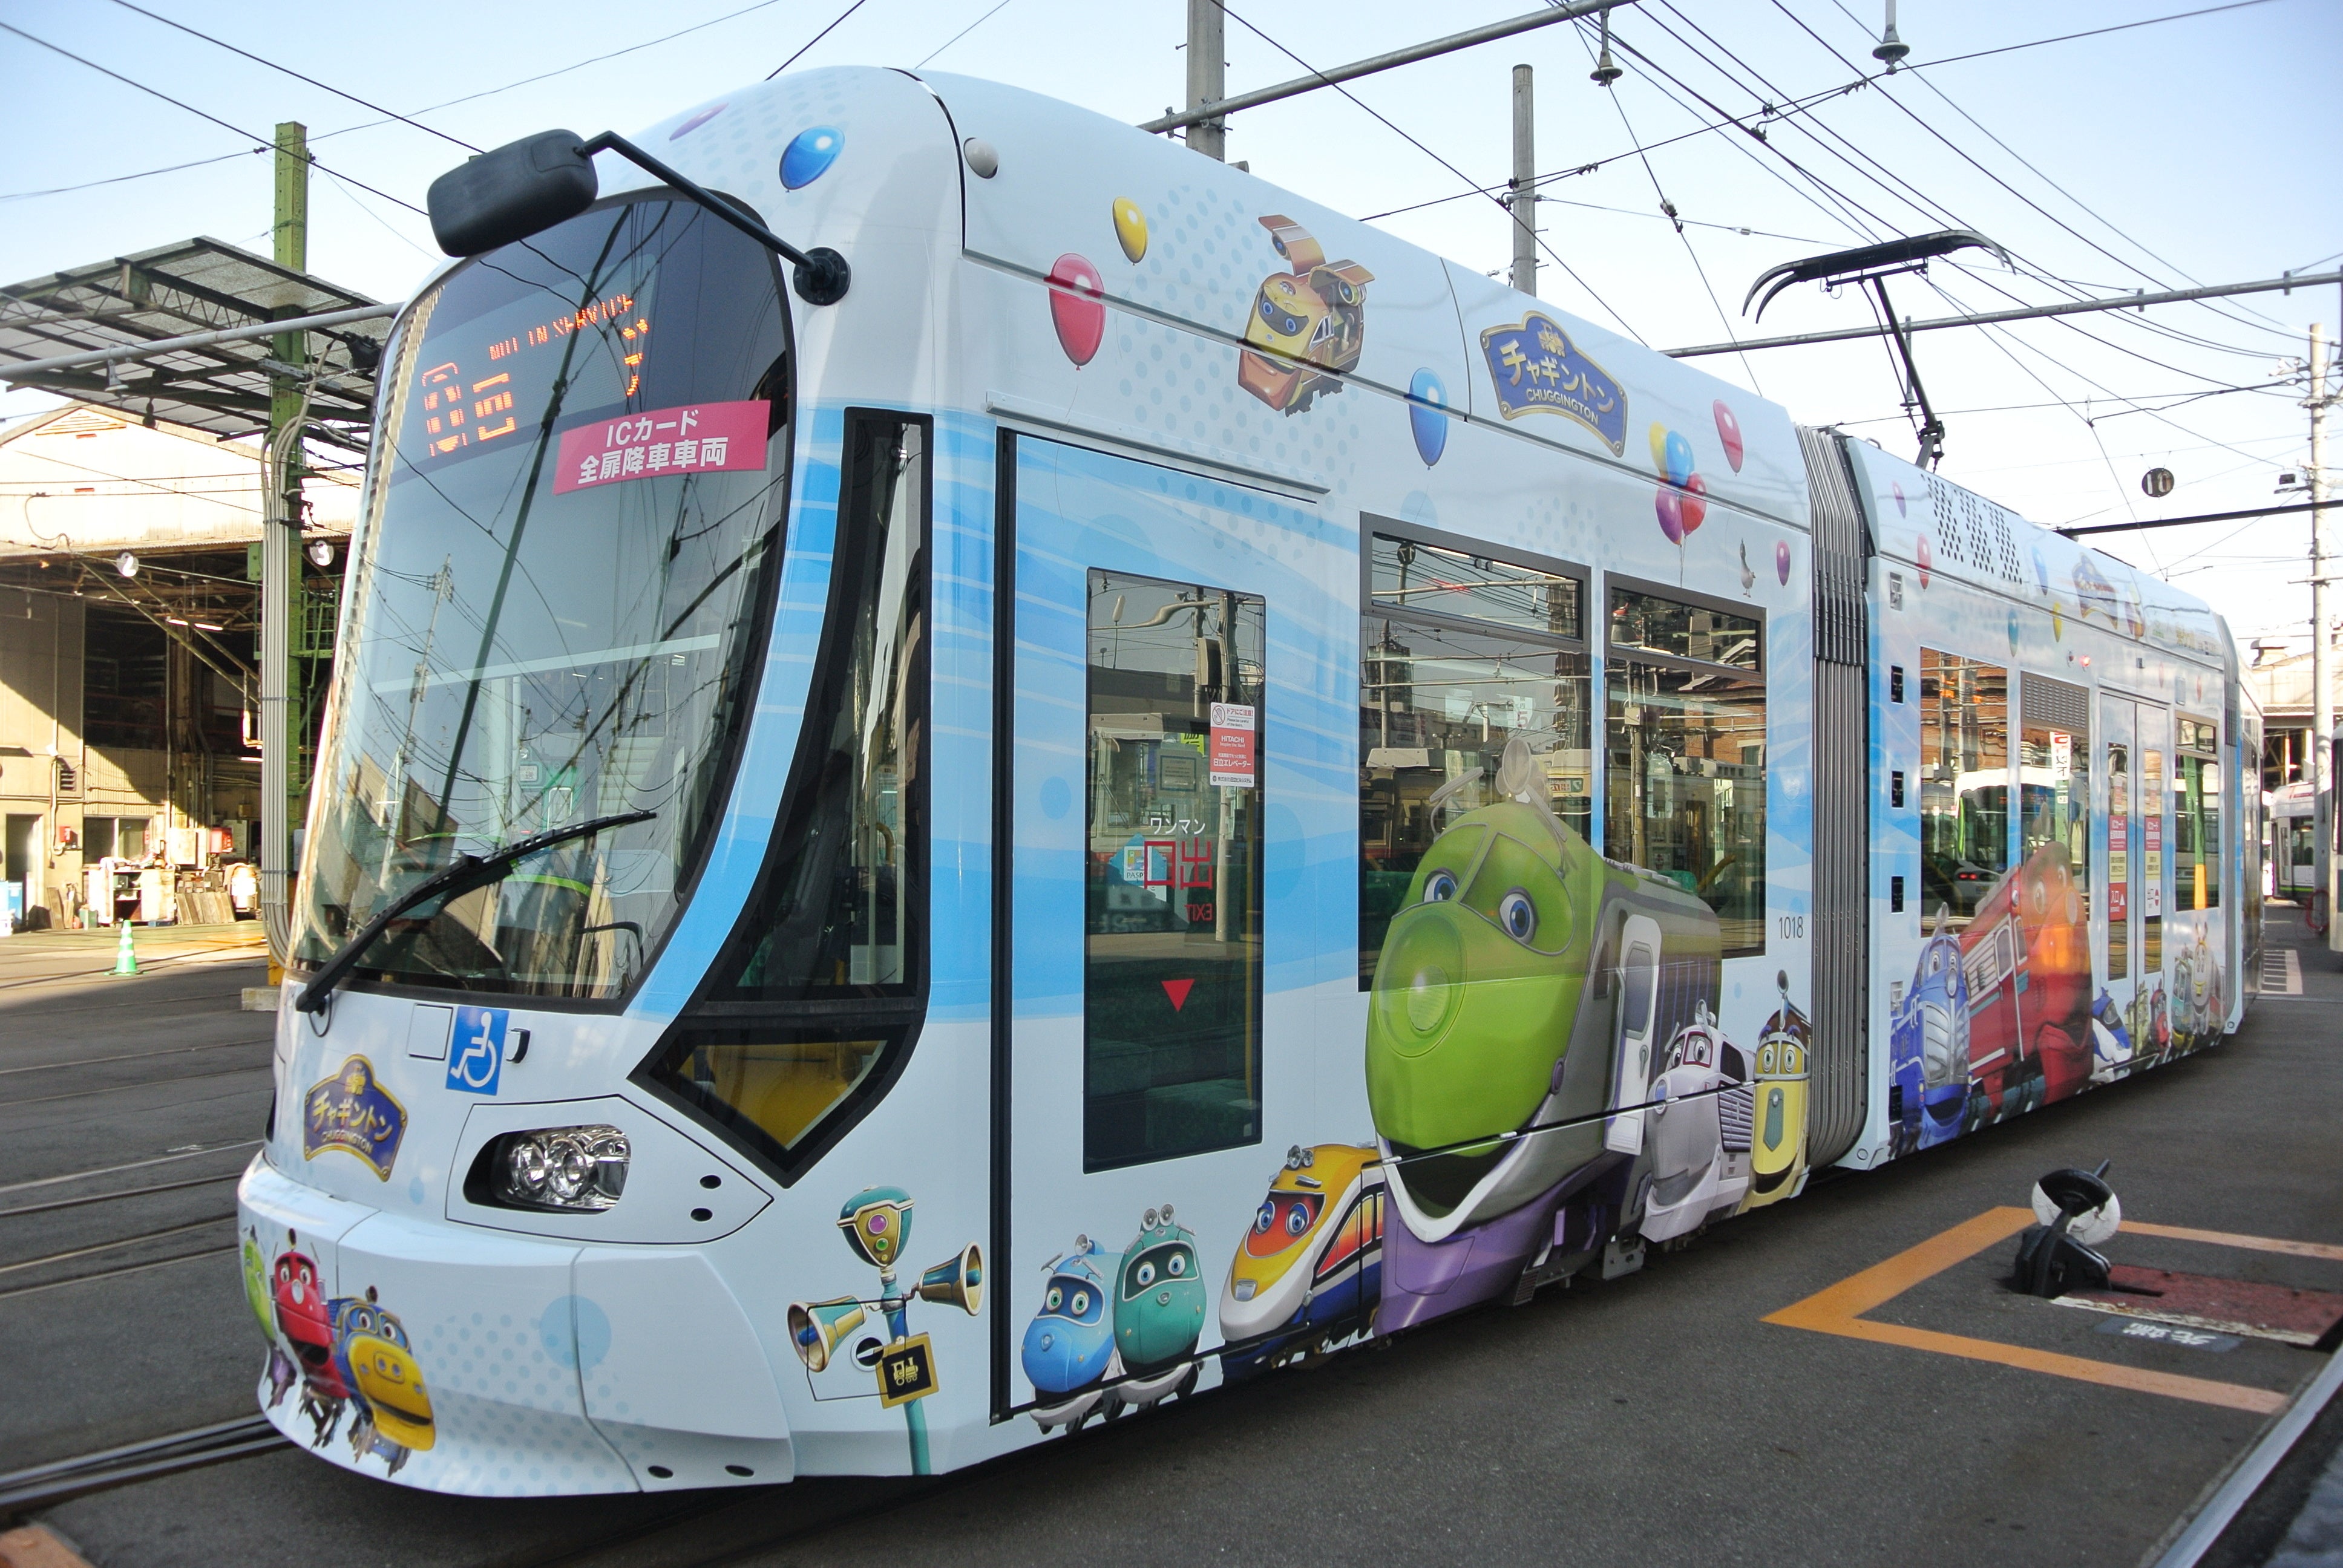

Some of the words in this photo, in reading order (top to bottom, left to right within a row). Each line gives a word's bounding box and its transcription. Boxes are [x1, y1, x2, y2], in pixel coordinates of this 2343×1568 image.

[1499, 339, 1614, 413] チャギントン
[1525, 387, 1599, 425] CHUGGINGTON
[606, 409, 700, 447] ICカード
[577, 437, 729, 485] 全扉降車車両
[122, 552, 136, 577] 2
[316, 540, 330, 566] 3
[1213, 758, 1251, 768] 日立エレベーター
[1150, 817, 1205, 835] ワンマン
[1779, 916, 1803, 939] 1018
[312, 1090, 393, 1142] チャギントン
[321, 1129, 373, 1155] CHUGGINGTON
